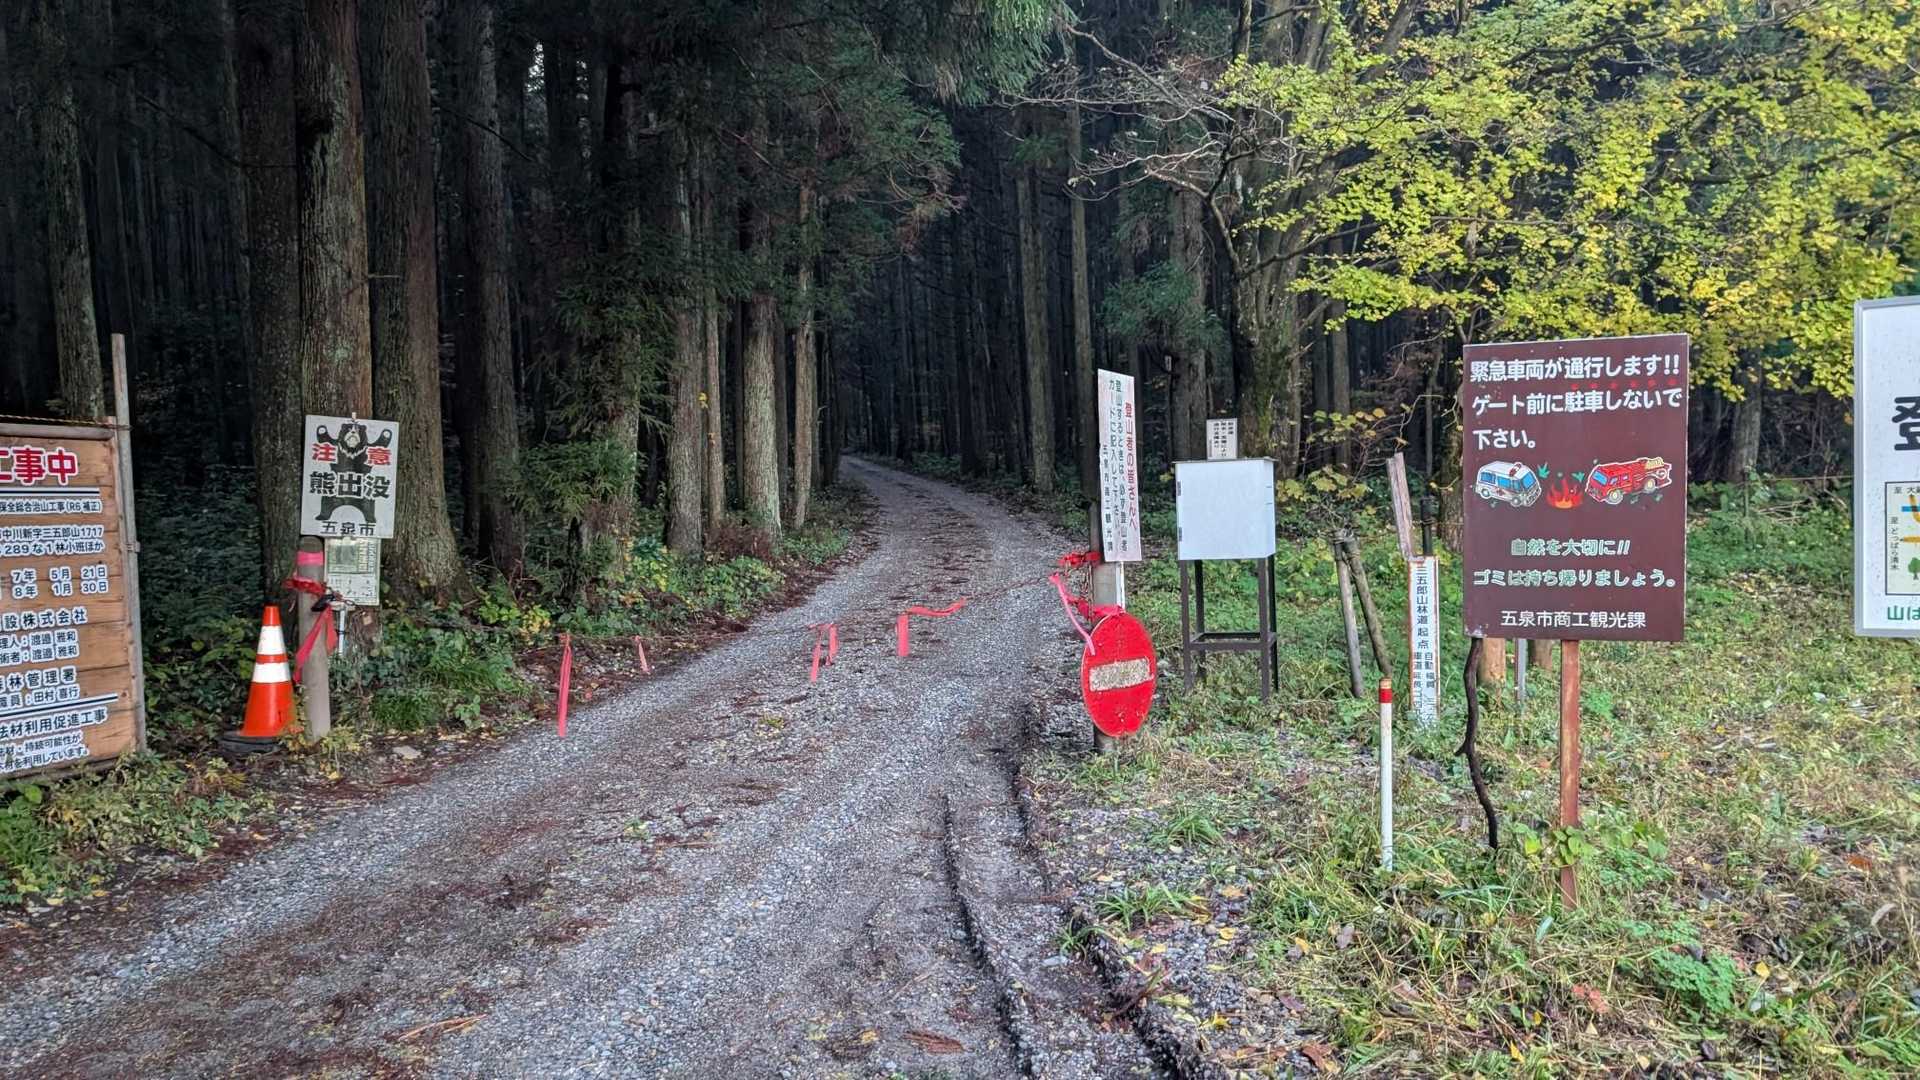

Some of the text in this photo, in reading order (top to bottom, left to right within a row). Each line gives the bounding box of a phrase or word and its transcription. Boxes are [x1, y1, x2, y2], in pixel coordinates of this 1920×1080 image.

[1470, 354, 1681, 382] 緊急車両が通行します!!
[1472, 388, 1682, 415] ゲート前に駐車しないで
[1472, 428, 1536, 450] 下さい。
[1124, 402, 1137, 530] 登山者の皆さんへ
[309, 471, 391, 499] 熊出没
[0, 527, 103, 540] 中川新字三五郎山1717
[320, 521, 376, 537] 五泉市
[1511, 538, 1631, 556] 自然を大切に!!
[1473, 569, 1677, 588] ゴミは持ち帰りましょう。
[1500, 609, 1646, 629] 五泉市商工観光課
